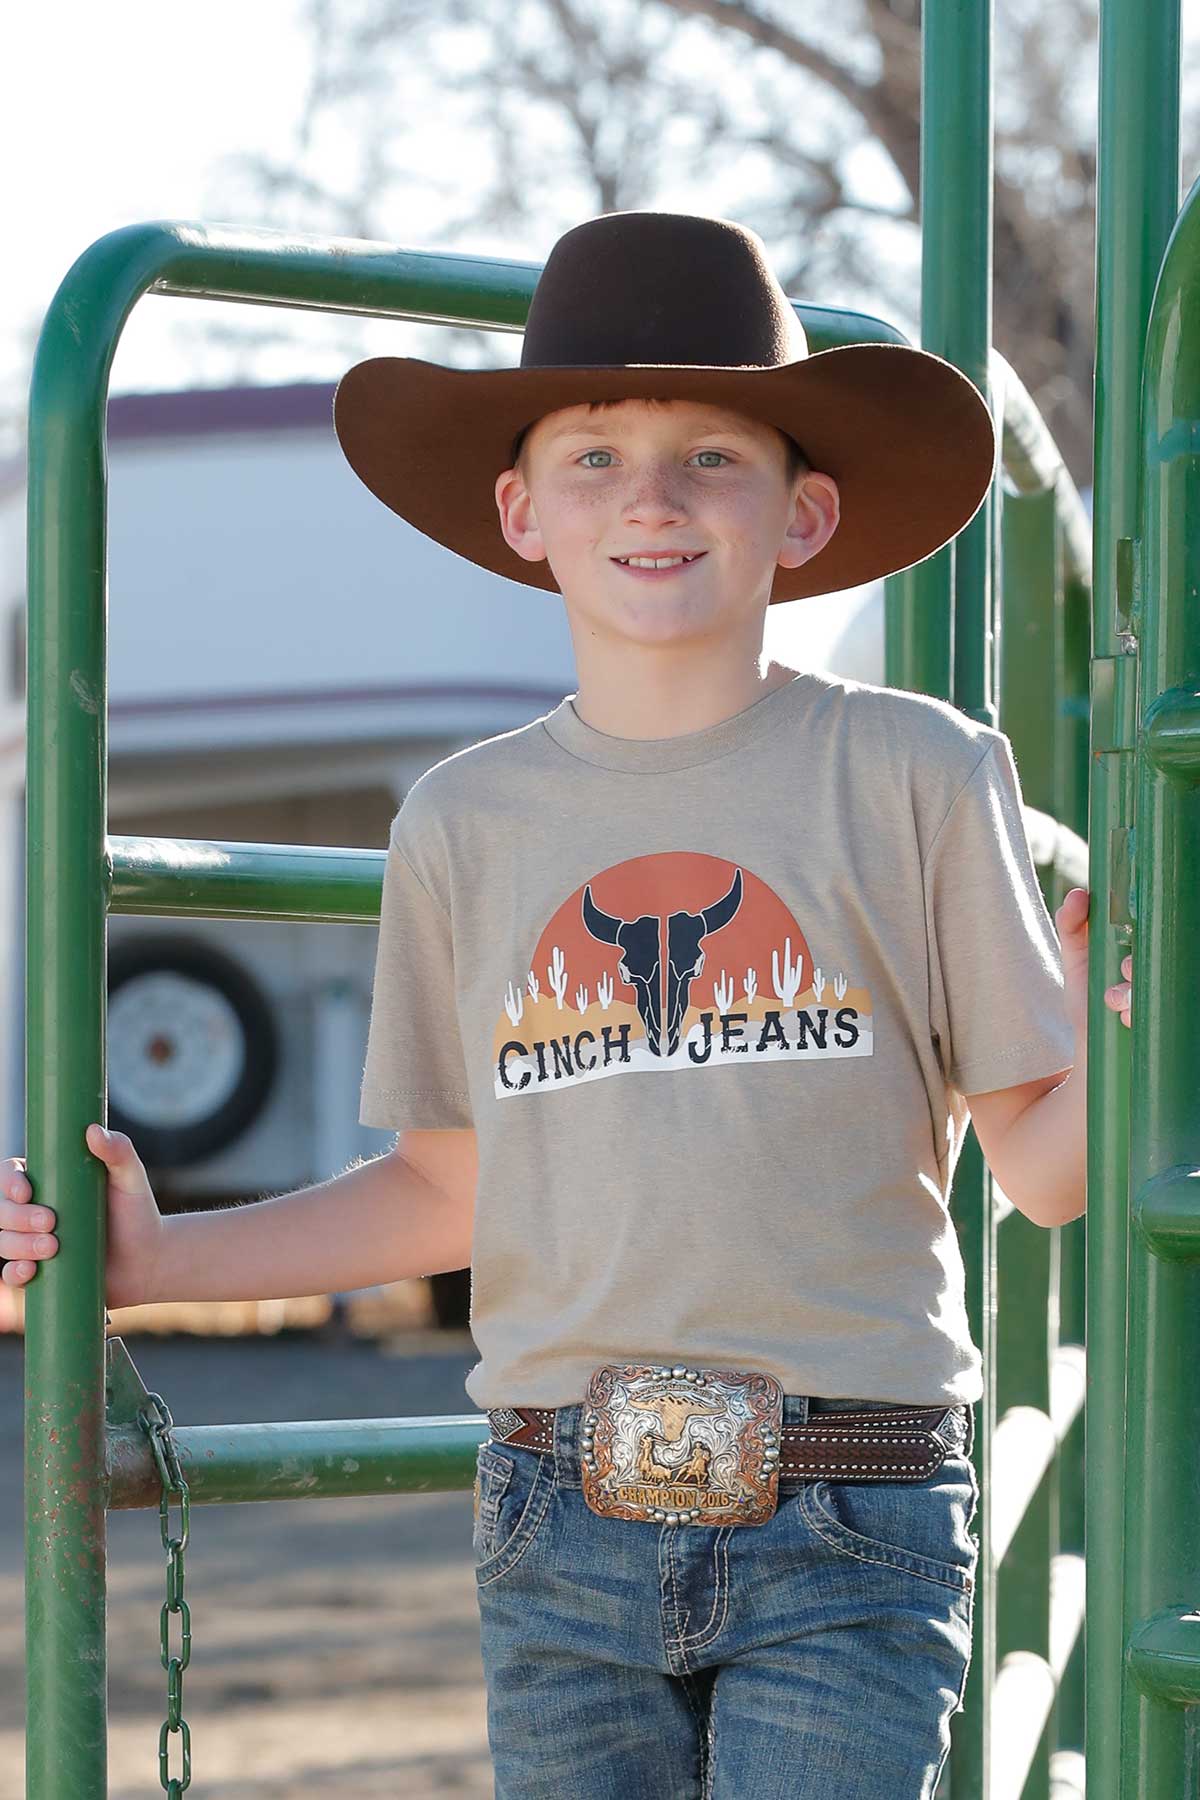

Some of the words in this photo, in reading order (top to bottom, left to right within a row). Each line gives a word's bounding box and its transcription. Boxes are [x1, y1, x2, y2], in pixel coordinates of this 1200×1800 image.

[498, 1024, 632, 1090] CINCH
[688, 1008, 860, 1063] JEANS
[619, 1486, 696, 1507] CHAMPION
[700, 1492, 729, 1507] 2016
